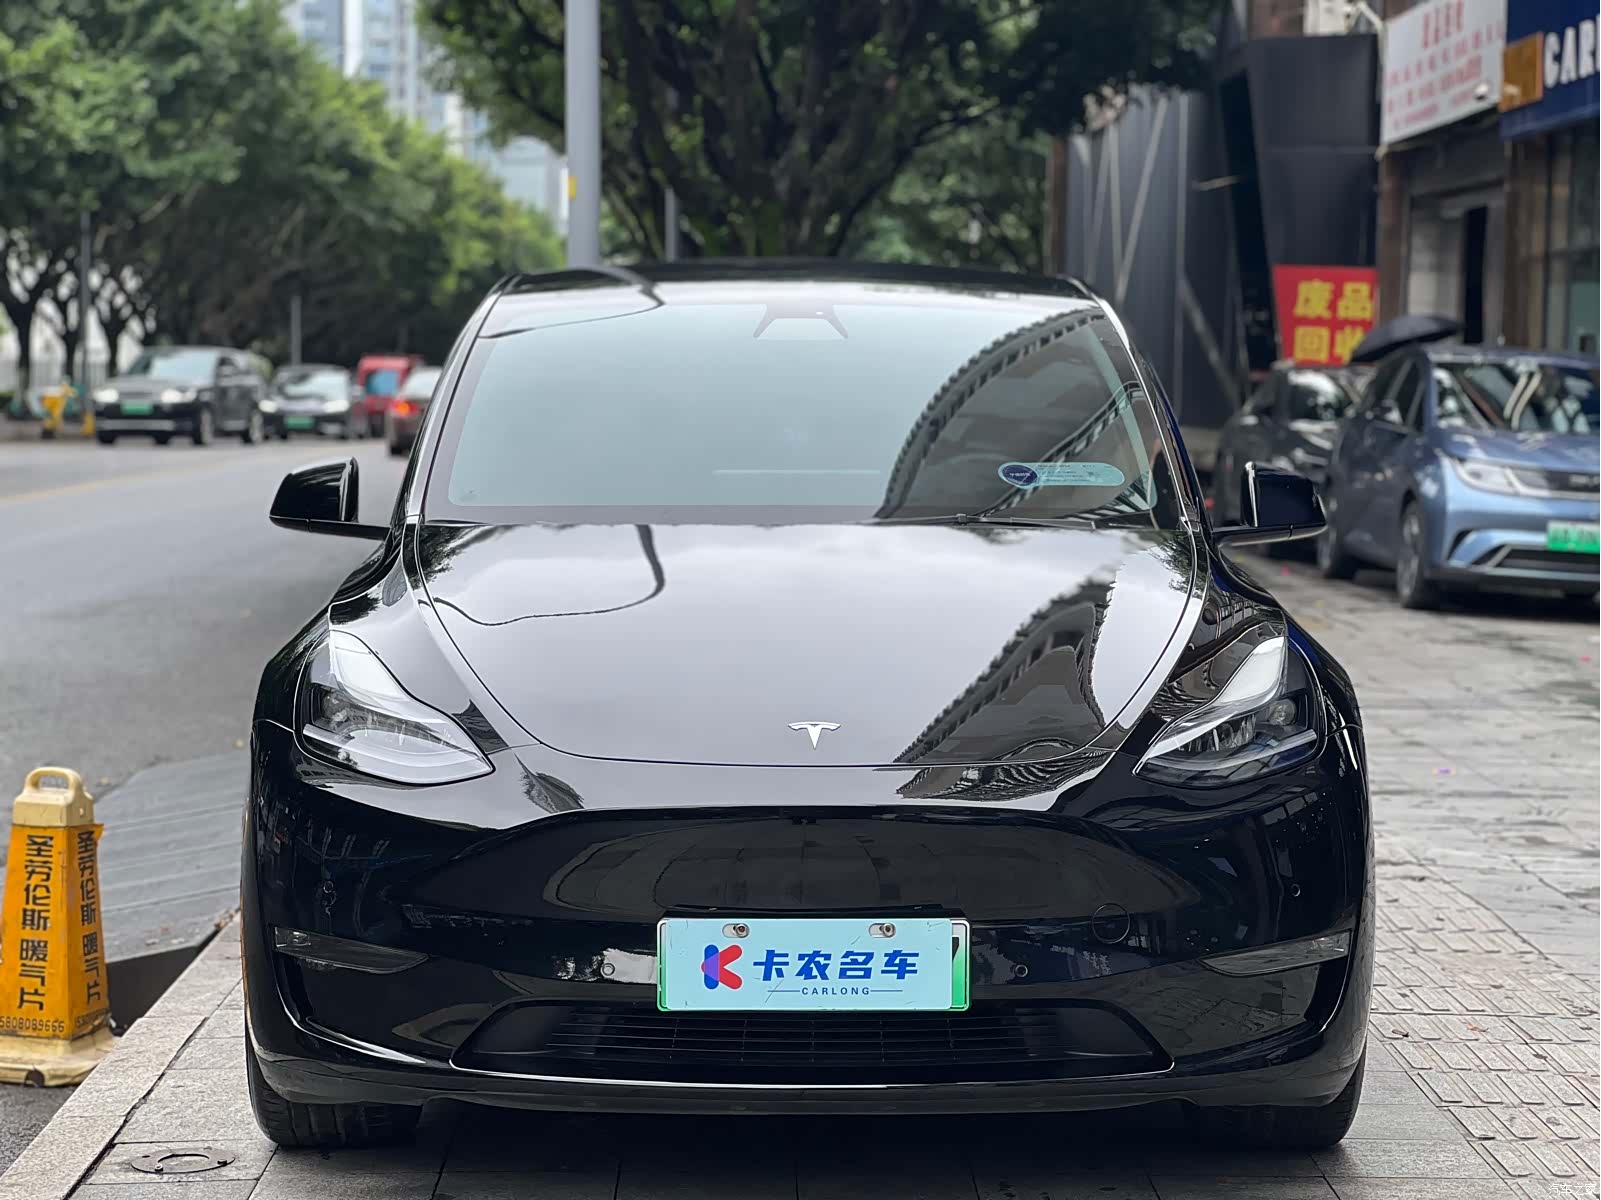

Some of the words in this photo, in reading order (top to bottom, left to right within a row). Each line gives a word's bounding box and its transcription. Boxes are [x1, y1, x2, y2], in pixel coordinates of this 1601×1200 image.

[1293, 279, 1374, 319] 废品
[22, 834, 54, 931] 圣劳伦斯
[78, 830, 97, 926] 圣劳伦斯
[18, 939, 48, 1011] 暖气片
[83, 932, 101, 1006] 暖气片
[753, 949, 920, 982] 卡农名车
[801, 986, 870, 996] CARLONG
